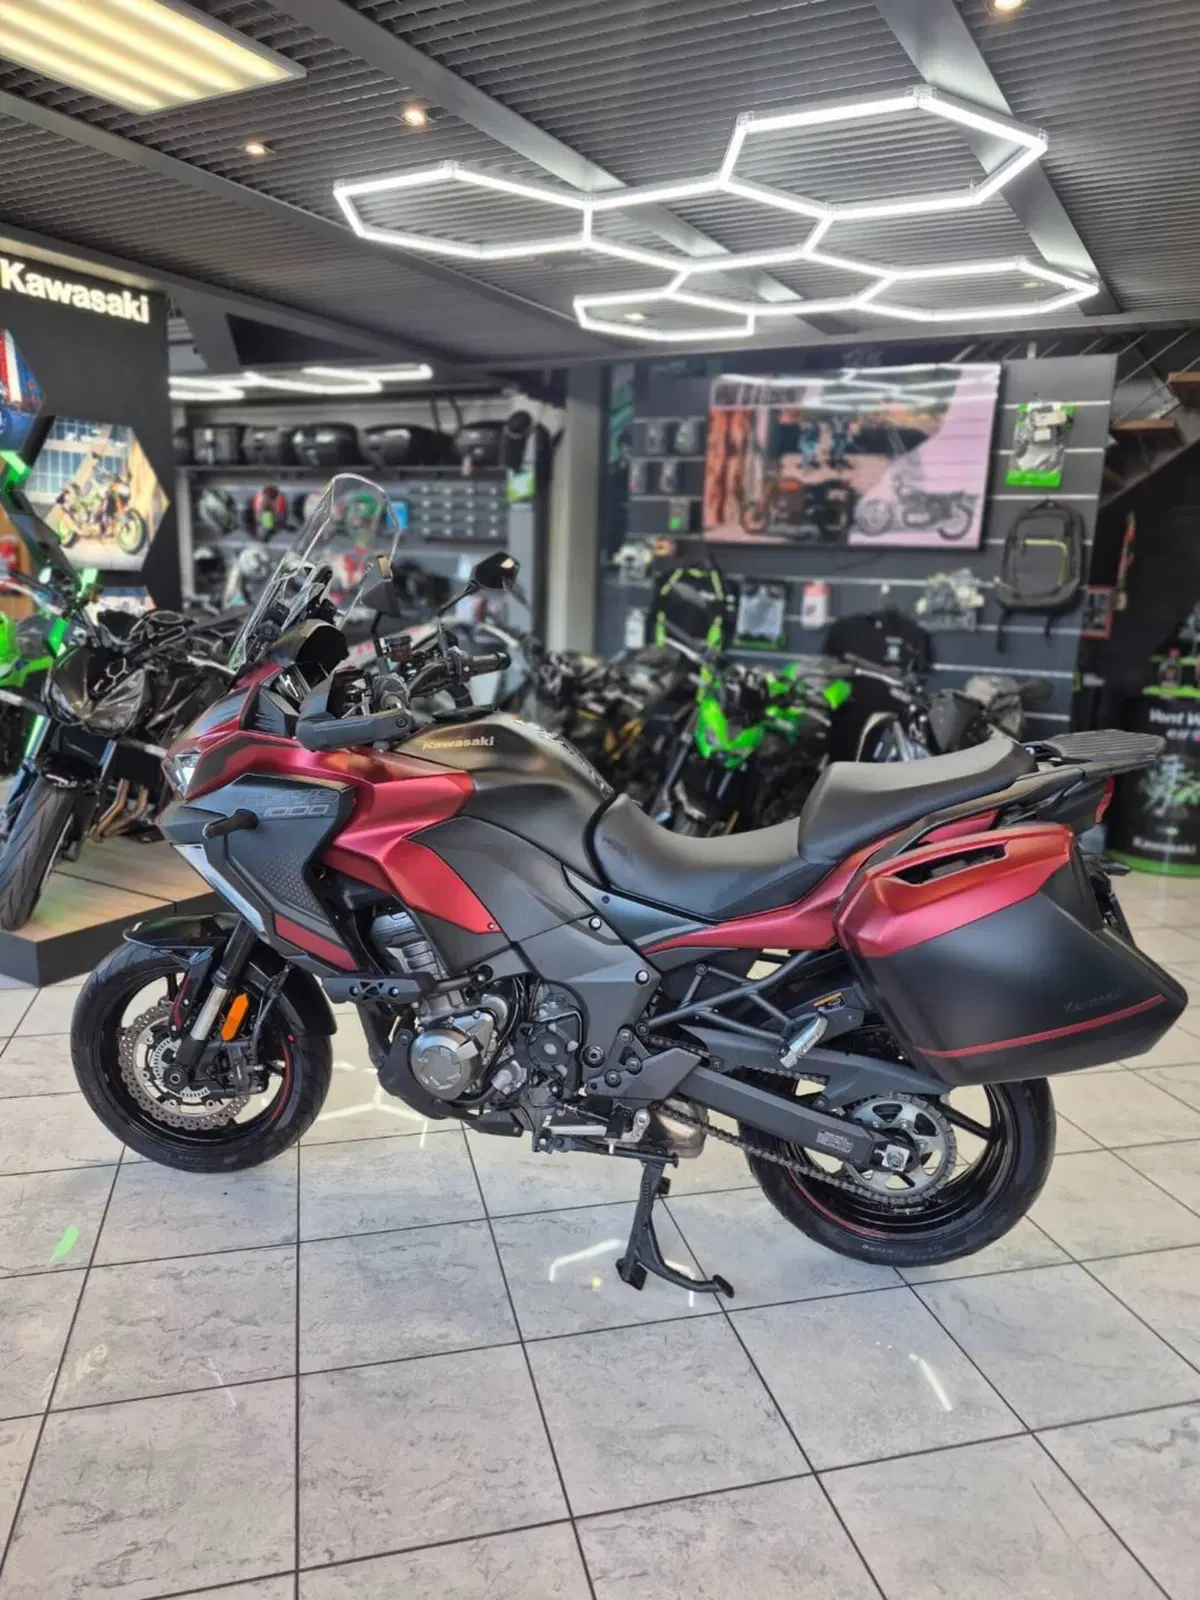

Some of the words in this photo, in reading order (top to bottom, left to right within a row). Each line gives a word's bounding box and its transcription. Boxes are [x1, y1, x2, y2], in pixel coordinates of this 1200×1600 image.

[0, 258, 149, 324] Kawasaki
[422, 736, 494, 750] Kawasaki
[264, 804, 329, 817] 1000
